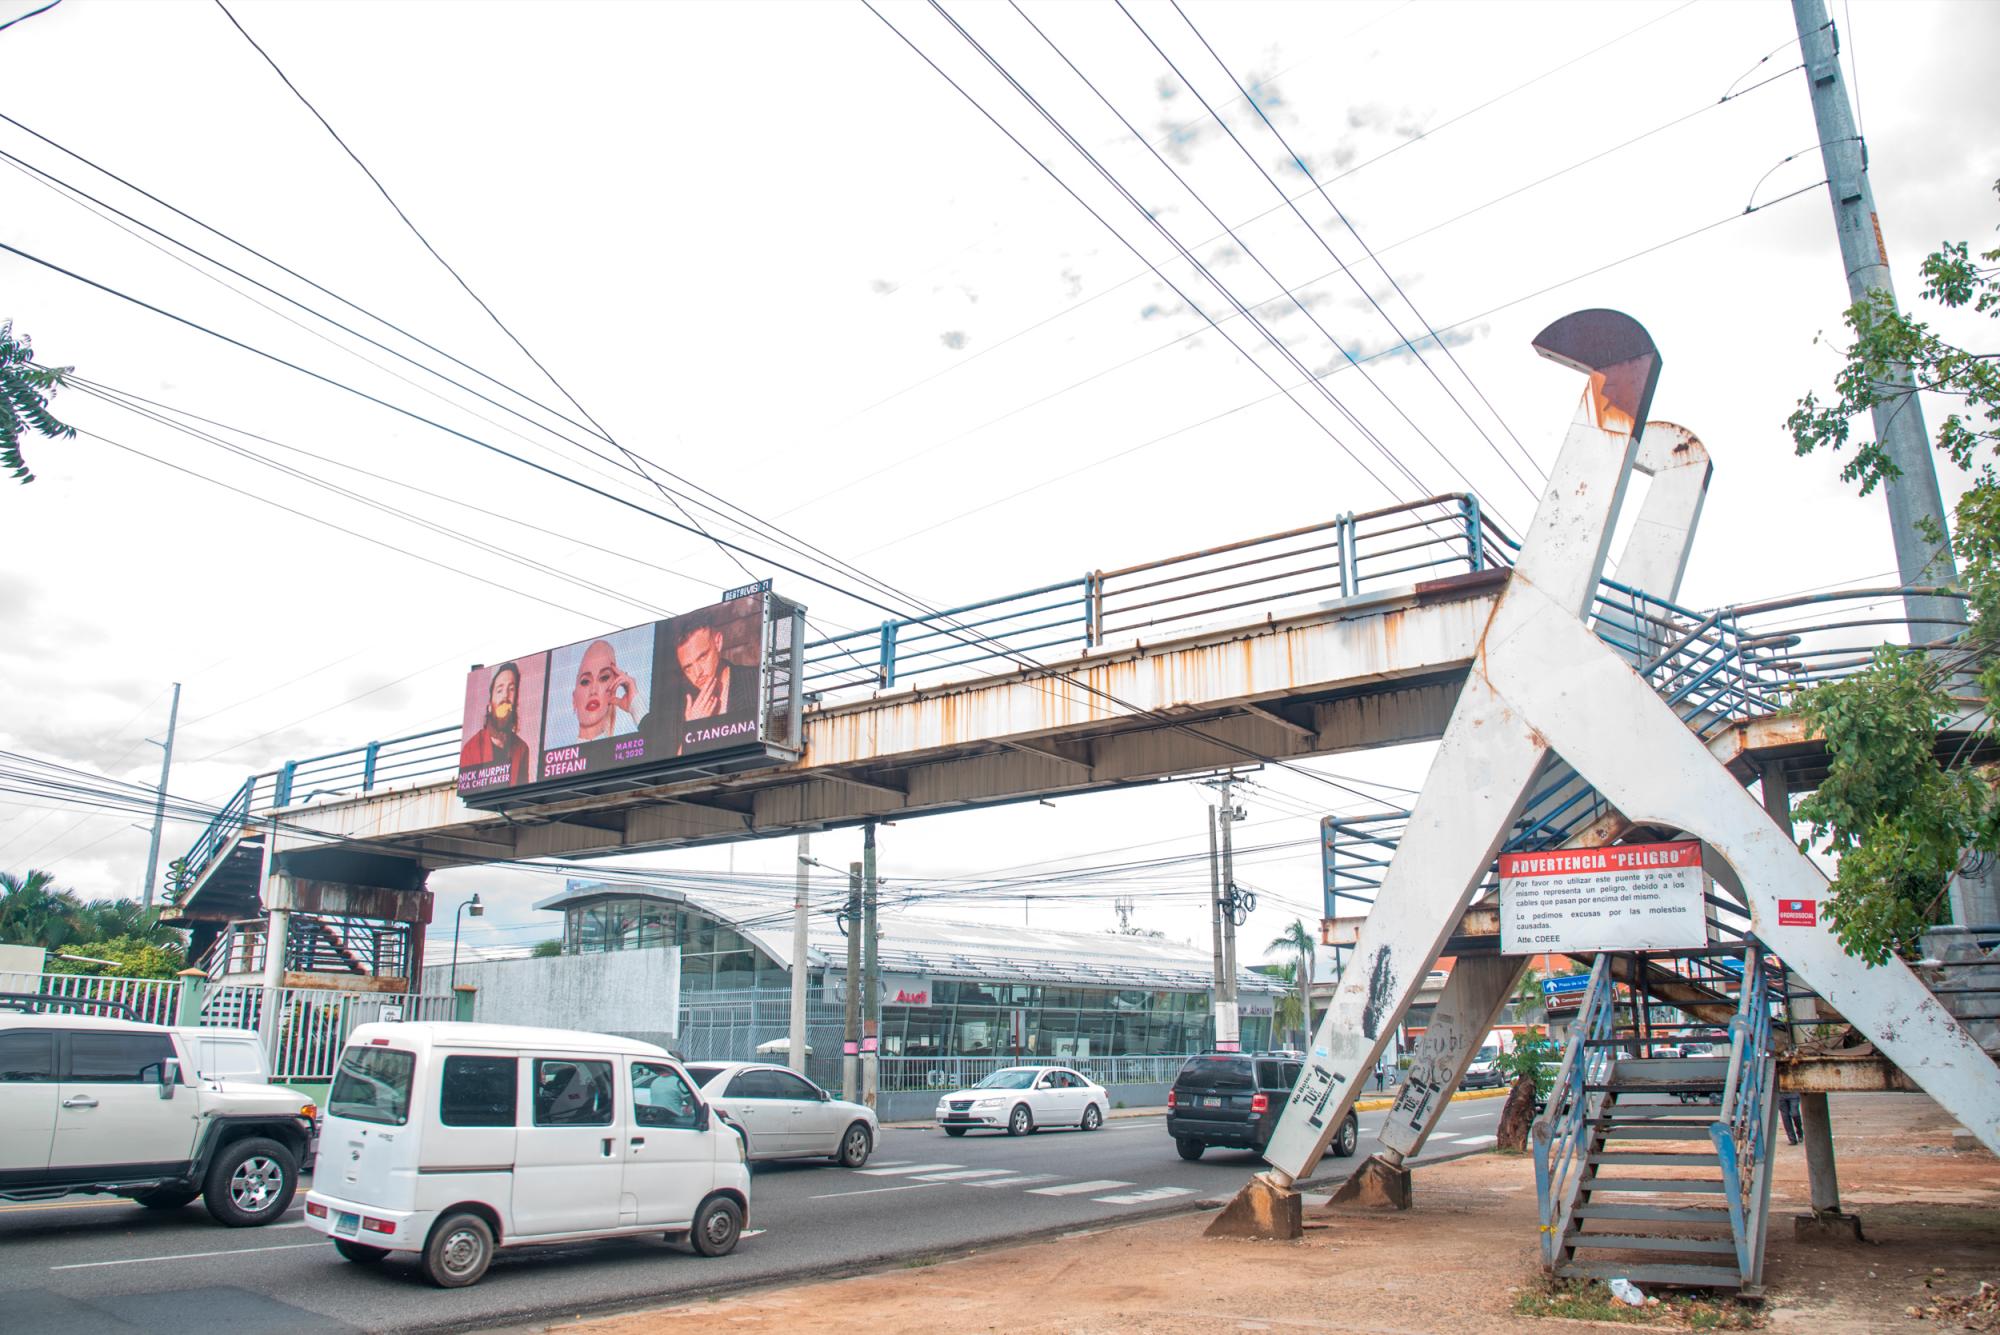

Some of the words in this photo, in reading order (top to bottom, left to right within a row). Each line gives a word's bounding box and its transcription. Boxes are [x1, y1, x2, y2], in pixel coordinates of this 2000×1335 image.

[684, 719, 756, 744] C.TANGANA
[615, 738, 644, 751] MARZO
[545, 746, 580, 764] GWEN
[459, 770, 477, 783] NICK
[480, 763, 511, 778] MURPHY
[544, 758, 587, 777] STEFANI
[472, 777, 488, 788] CHET
[489, 773, 511, 785] FAKER
[1511, 854, 1607, 874] ADVERTENCIA
[1515, 880, 1528, 888] Por
[1531, 879, 1550, 887] favor
[1615, 874, 1640, 883] puente
[1645, 873, 1654, 881] ya
[1658, 872, 1673, 880] que
[1677, 871, 1684, 879] el
[1515, 889, 1540, 897] mismo
[1543, 887, 1581, 897] representa
[1632, 882, 1658, 891] debido
[1515, 899, 1539, 907] cables
[1540, 898, 1553, 908] que
[1554, 897, 1577, 906] pasan
[1578, 896, 1591, 905] por
[1592, 895, 1621, 903] encima
[1532, 911, 1563, 920] pedimos
[1570, 910, 1601, 918] excusas
[1609, 909, 1621, 917] por
[1629, 907, 1641, 915] las
[1648, 905, 1687, 914] molestias
[1534, 934, 1561, 943] CDEEE
[895, 989, 928, 1004] Audi
[1292, 1094, 1301, 1104] No
